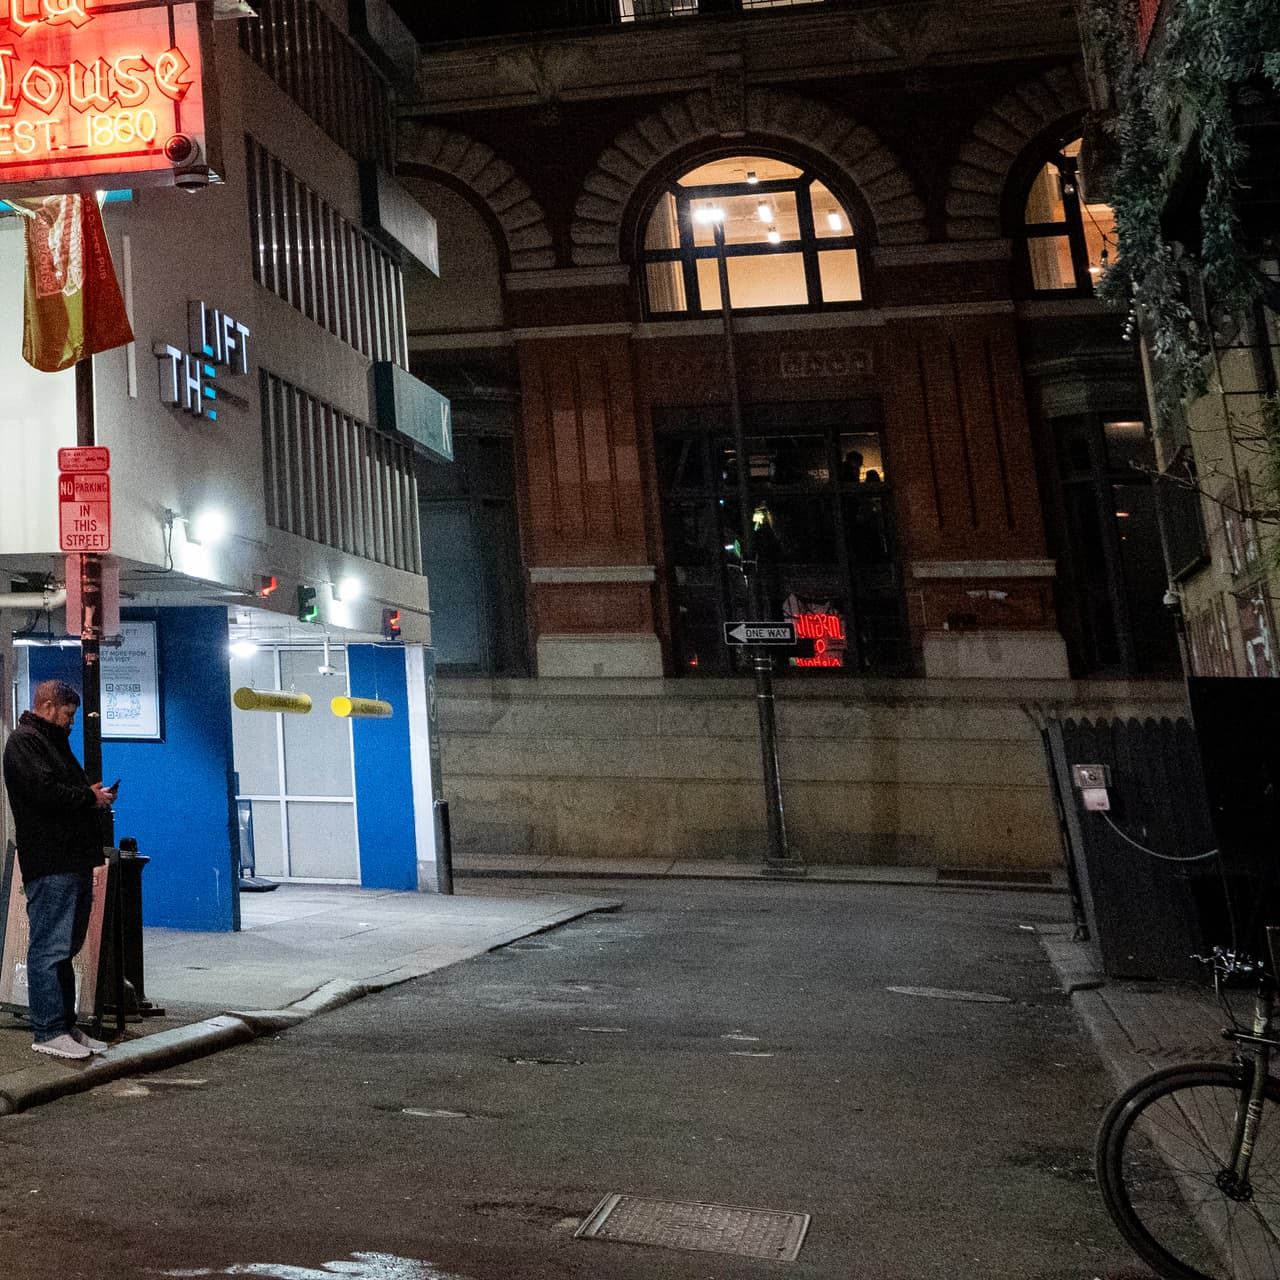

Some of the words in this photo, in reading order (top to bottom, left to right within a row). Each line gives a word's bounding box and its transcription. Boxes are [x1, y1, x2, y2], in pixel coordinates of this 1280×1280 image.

[84, 108, 157, 149] 1860
[200, 300, 250, 375] LIFT
[166, 343, 218, 421] THE
[60, 480, 74, 496] NO
[75, 482, 107, 493] PARKING
[80, 505, 90, 516] IN
[74, 520, 97, 531] THIS
[66, 534, 105, 547] STREET
[745, 629, 764, 638] ONE
[767, 628, 787, 638] WAY
